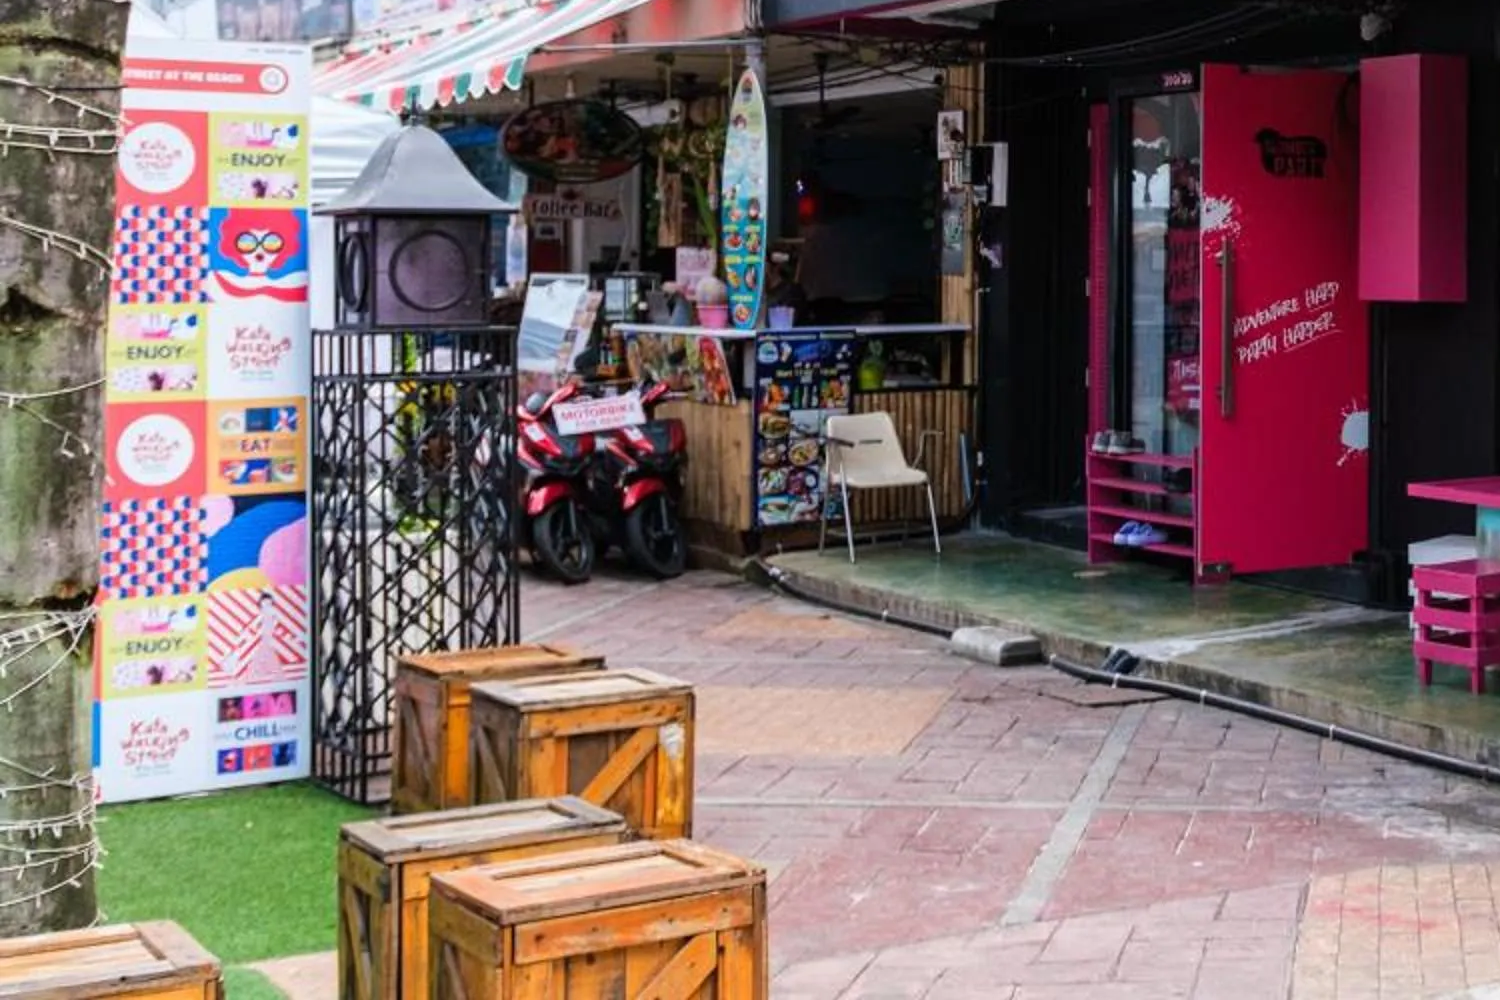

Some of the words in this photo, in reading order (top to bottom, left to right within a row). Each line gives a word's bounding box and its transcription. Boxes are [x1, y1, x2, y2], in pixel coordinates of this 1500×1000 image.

[231, 152, 286, 167] ENJOY
[127, 344, 184, 360] ENJOY
[240, 438, 272, 452] EAT
[126, 637, 183, 656] ENJOY
[234, 720, 279, 741] CHILL
